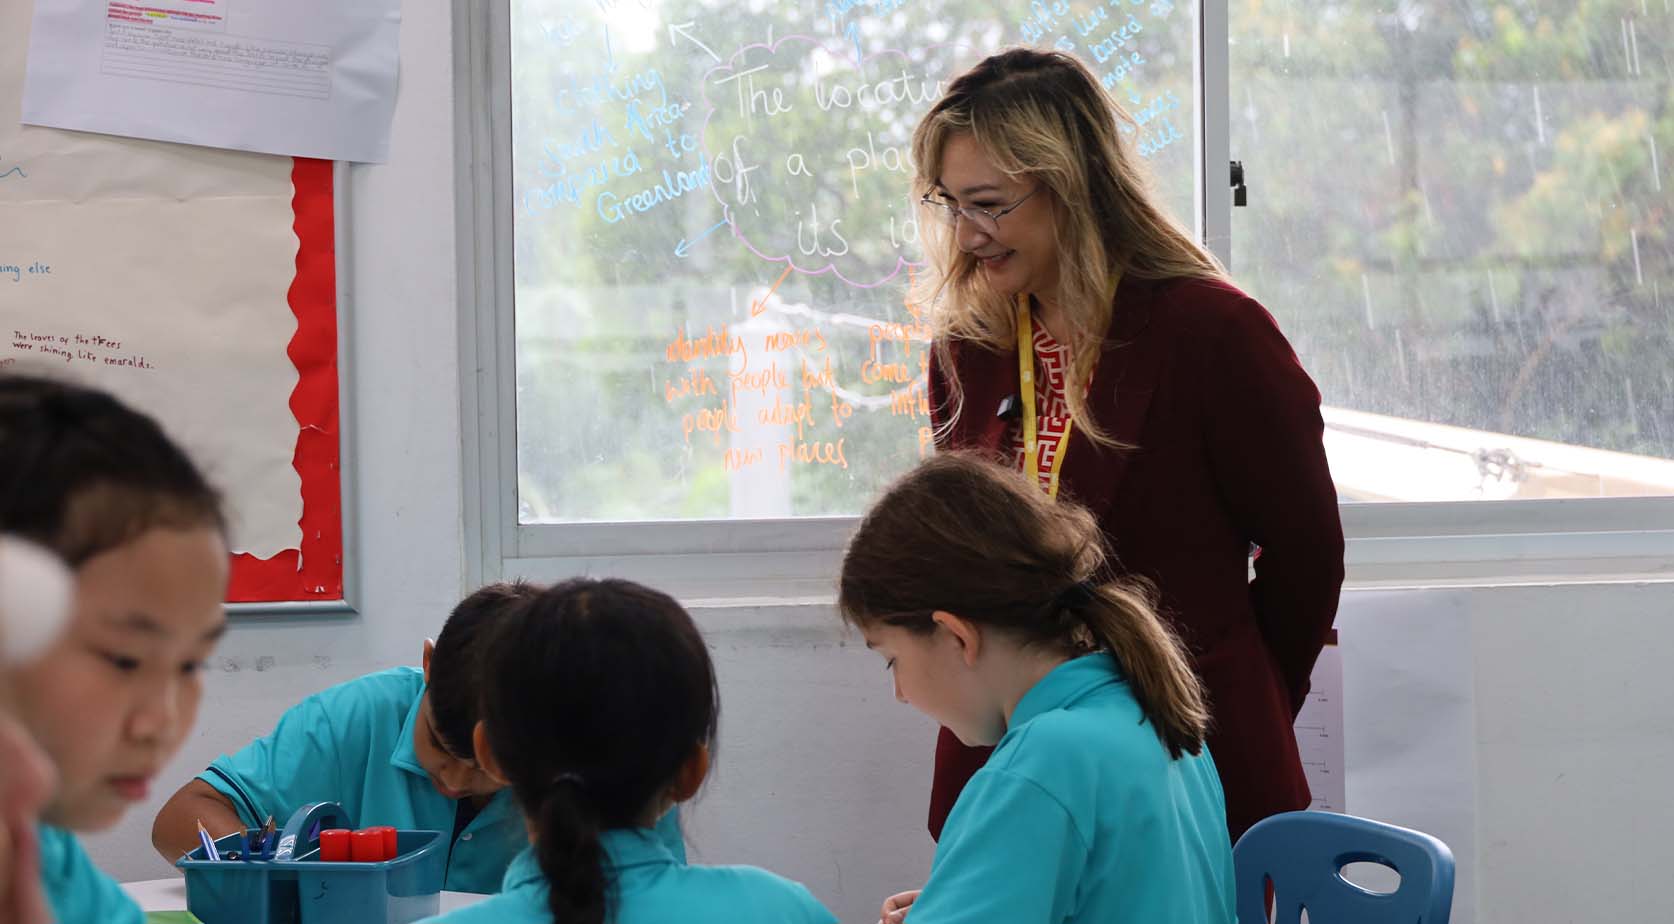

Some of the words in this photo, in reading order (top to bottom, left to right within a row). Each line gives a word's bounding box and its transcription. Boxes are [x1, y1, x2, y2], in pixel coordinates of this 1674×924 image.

[1087, 14, 1143, 64] based
[714, 64, 793, 118] The
[815, 60, 946, 111] locati
[1102, 52, 1146, 90] mate
[665, 127, 698, 159] to
[597, 152, 712, 224] Greenland
[714, 135, 760, 206] of
[786, 153, 813, 177] a
[846, 131, 916, 199] plac
[794, 202, 849, 257] its
[28, 262, 52, 274] else
[12, 341, 33, 351] were
[39, 344, 73, 363] shining
[78, 348, 98, 363] like
[14, 330, 27, 341] The
[30, 332, 55, 342] leaves
[74, 333, 90, 346] the
[665, 322, 748, 377] identity
[765, 327, 827, 352] moves
[664, 367, 718, 401] with
[731, 358, 792, 408] people
[801, 353, 834, 390] but
[861, 360, 912, 385] come
[682, 399, 743, 447] people
[758, 393, 815, 440] adapt
[831, 388, 853, 427] to
[723, 447, 762, 472] new
[776, 434, 848, 475] places
